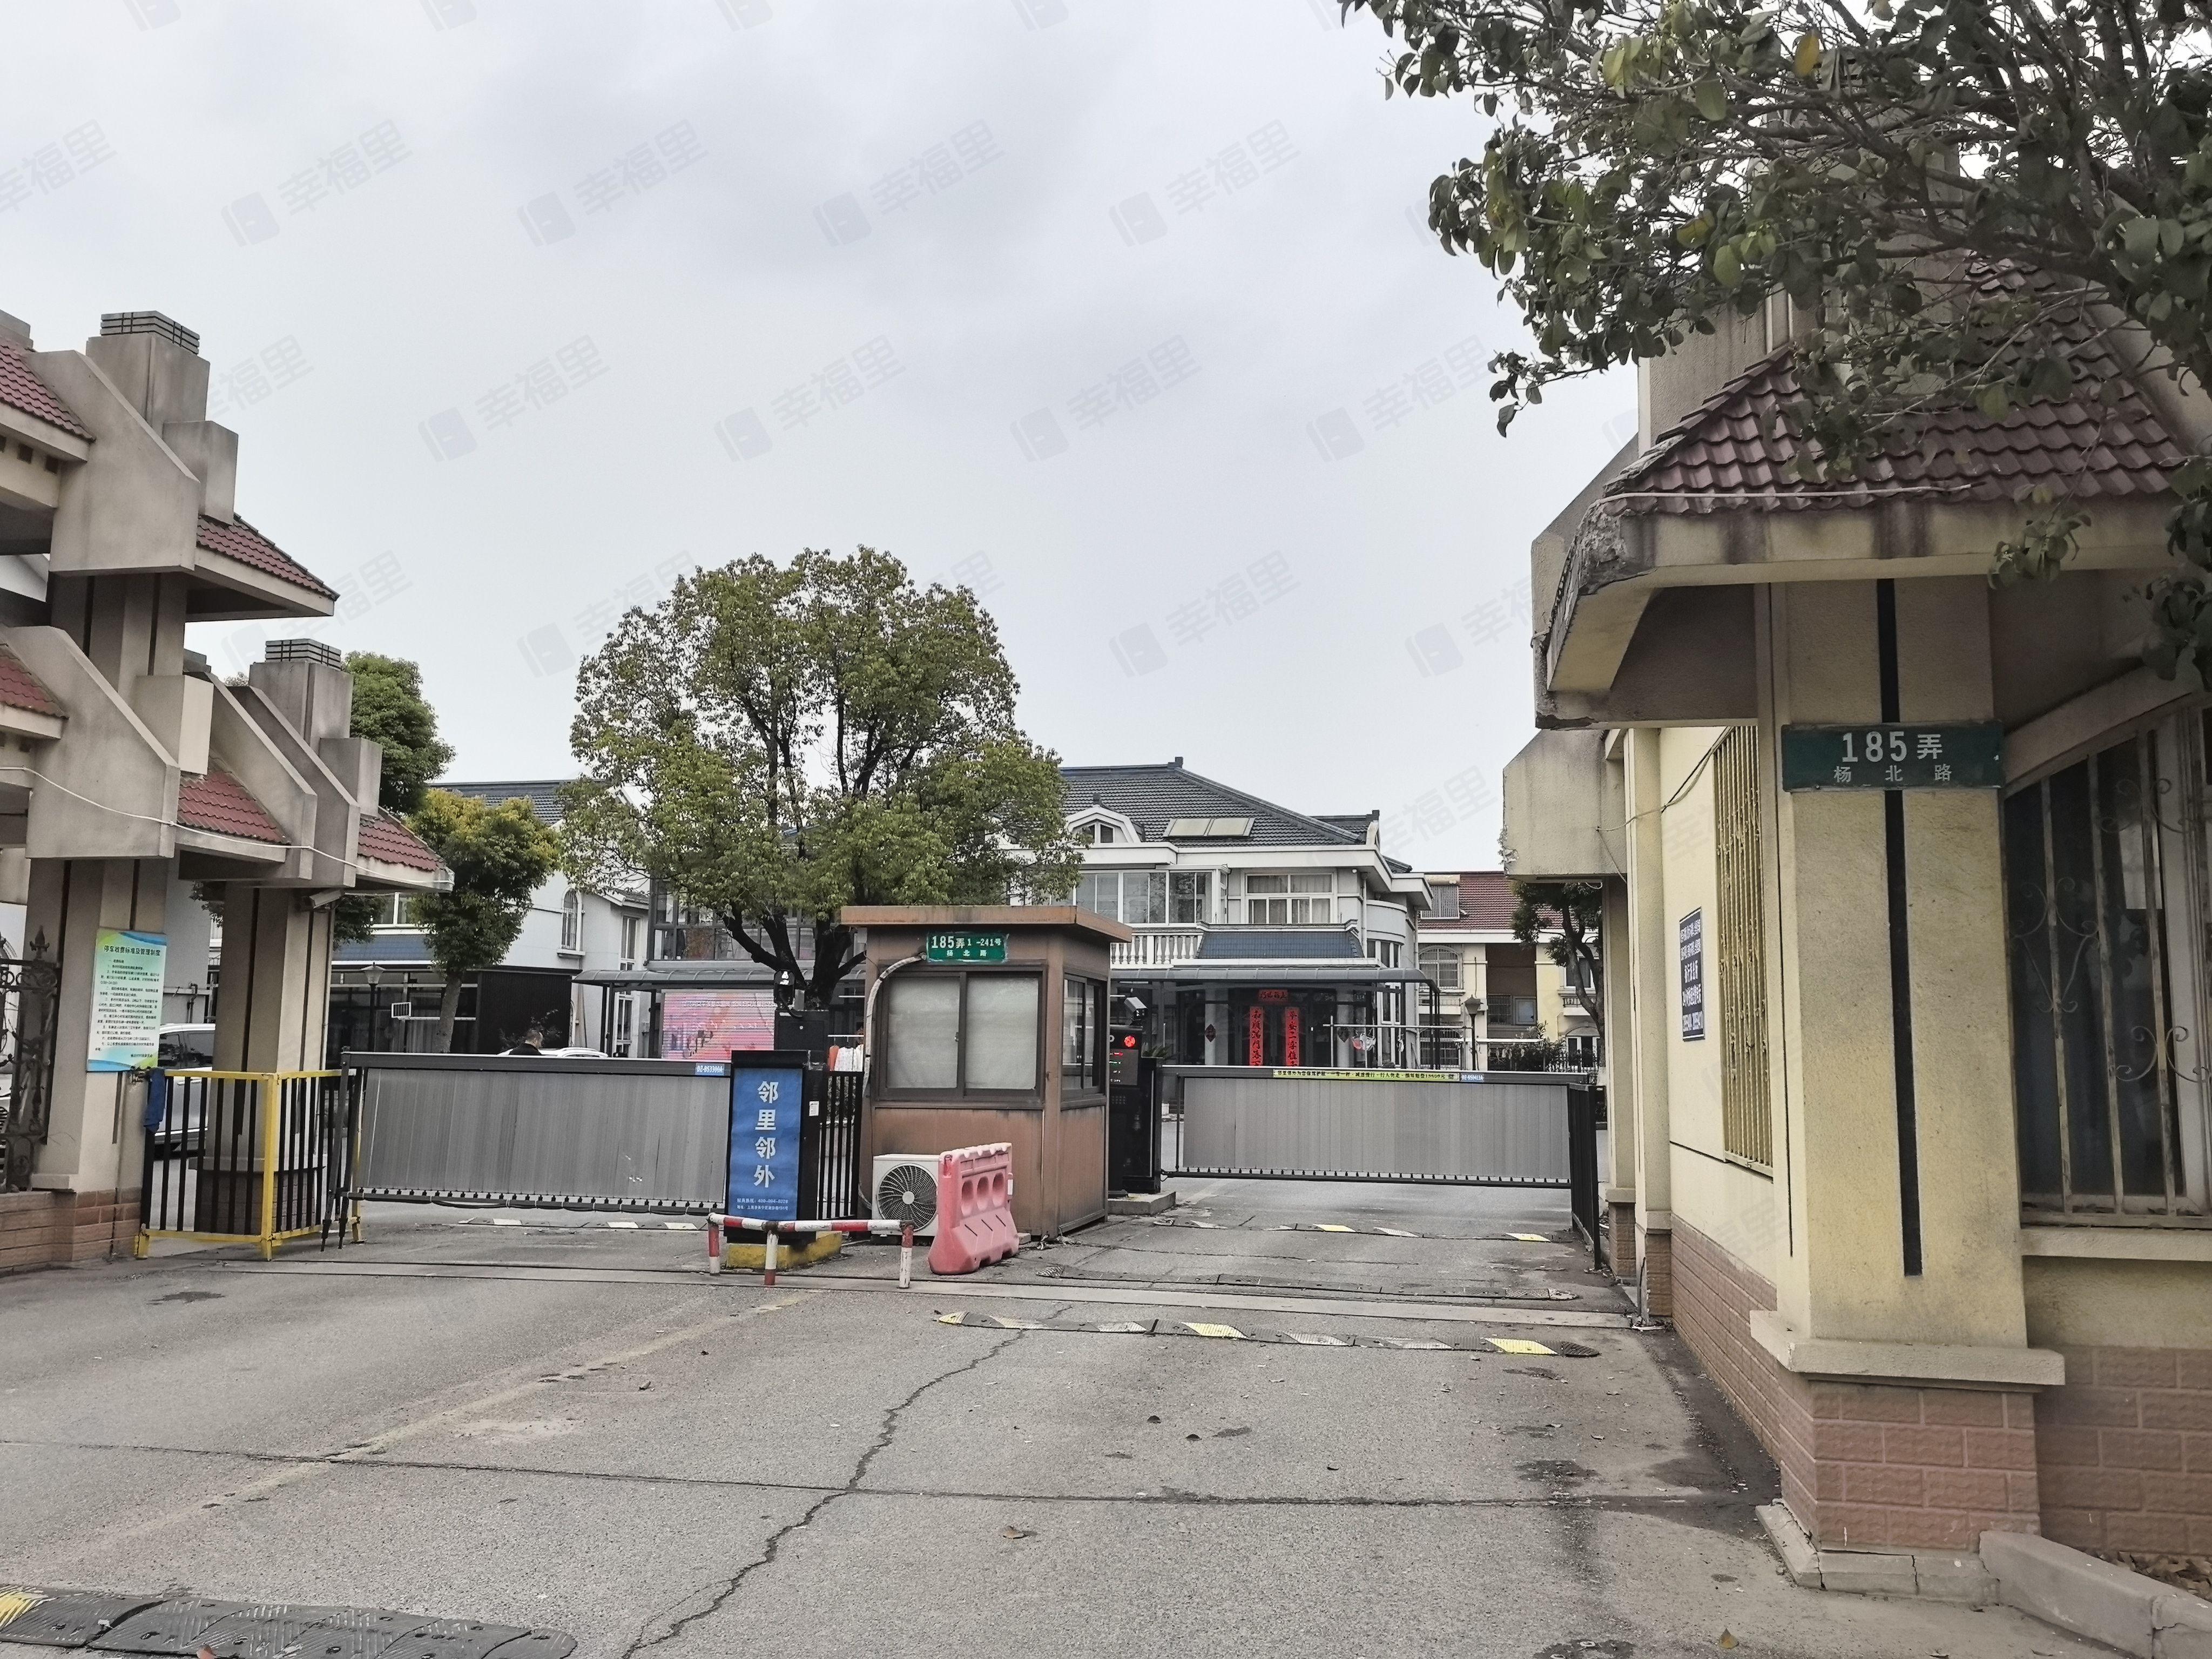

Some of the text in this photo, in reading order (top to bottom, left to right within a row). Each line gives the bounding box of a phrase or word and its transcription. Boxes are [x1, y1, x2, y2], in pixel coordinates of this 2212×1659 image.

[1842, 731, 1943, 763] 185弄
[1833, 764, 1952, 783] 杨北路
[753, 1081, 779, 1188] 邻里邻外
